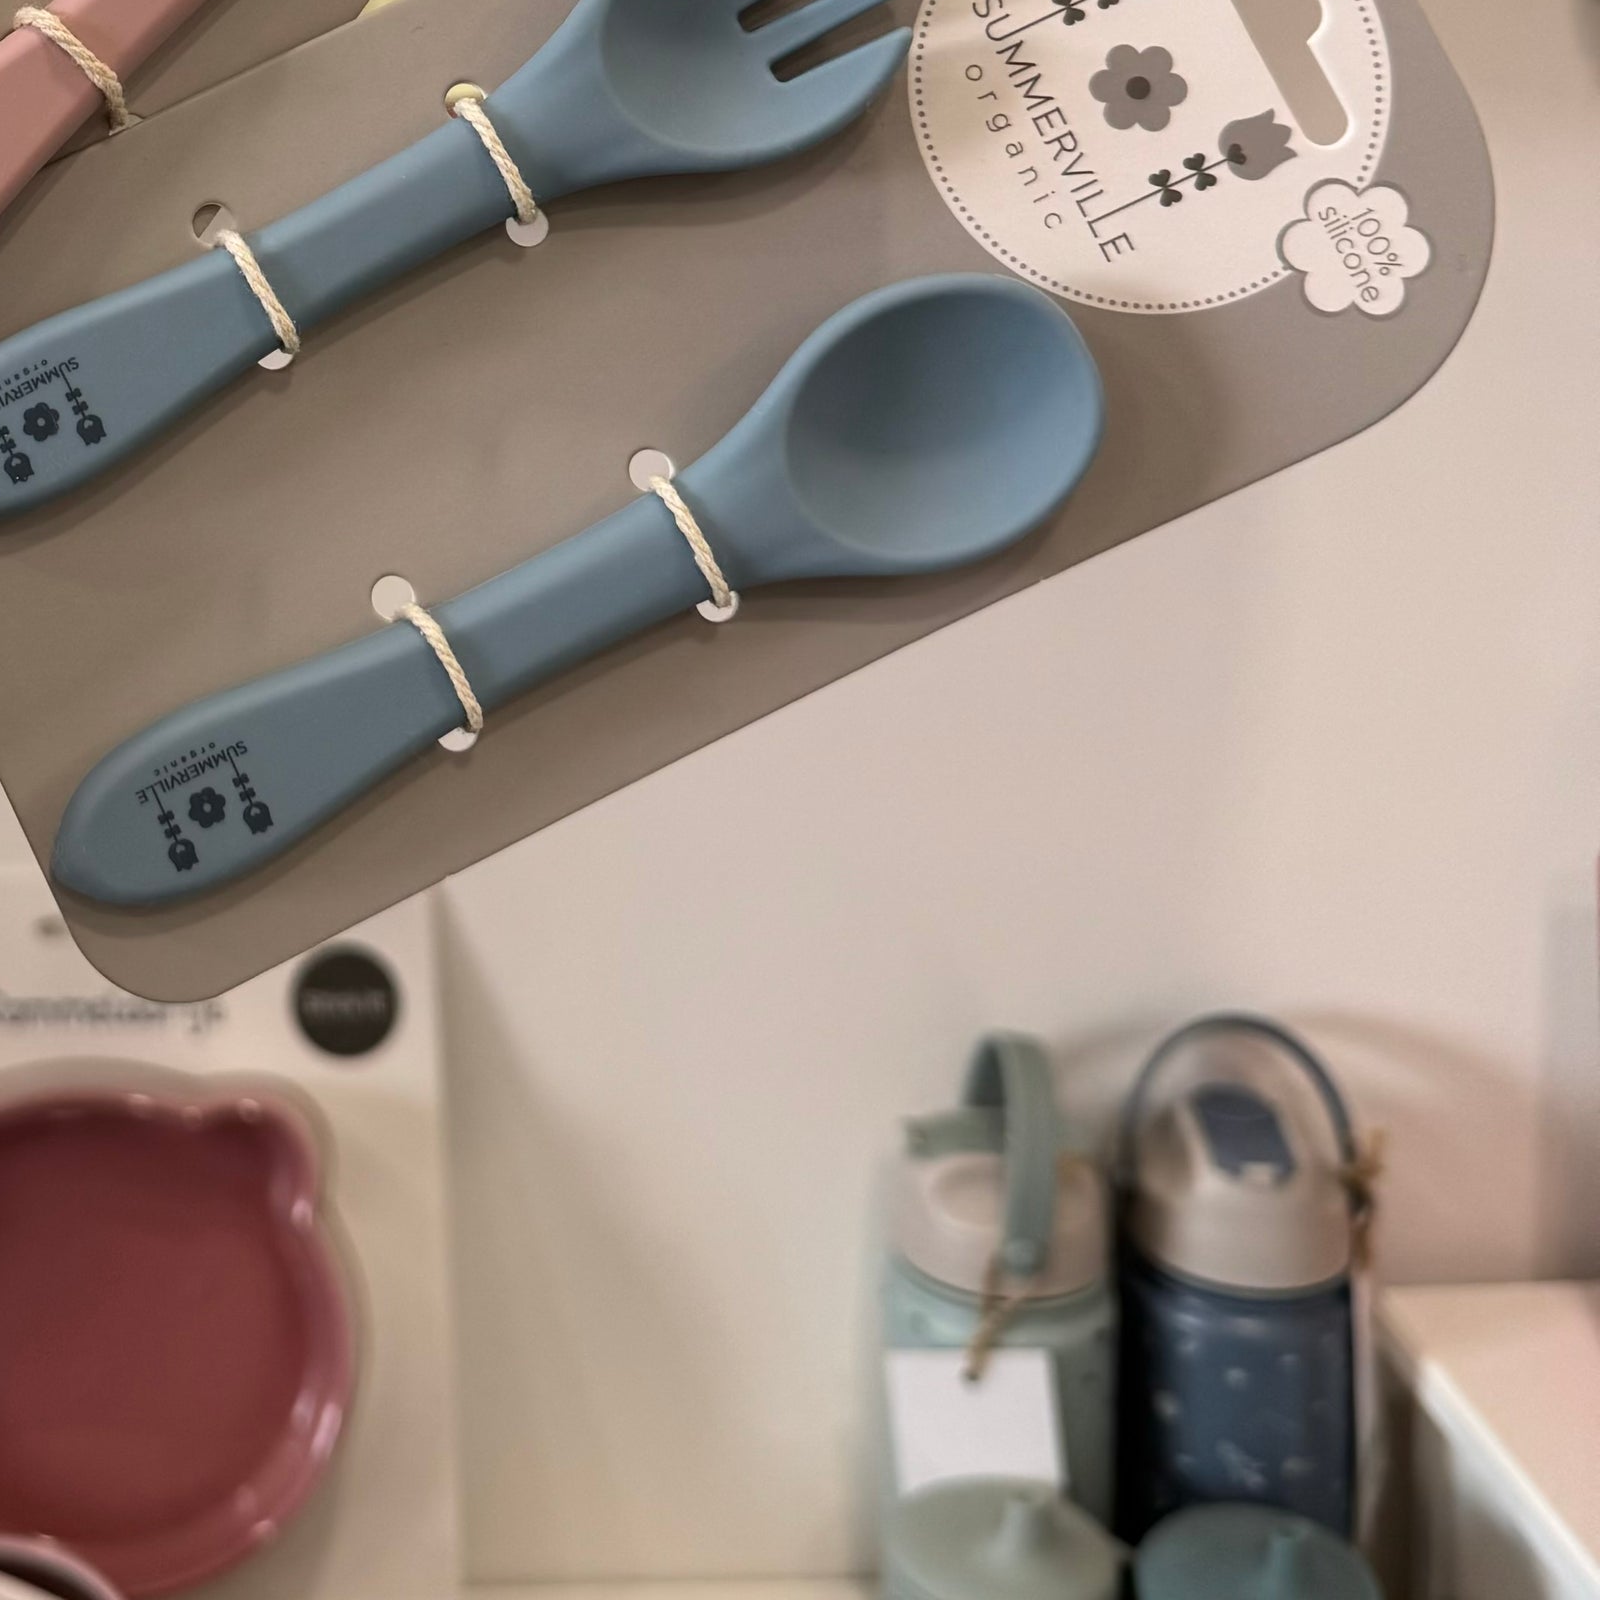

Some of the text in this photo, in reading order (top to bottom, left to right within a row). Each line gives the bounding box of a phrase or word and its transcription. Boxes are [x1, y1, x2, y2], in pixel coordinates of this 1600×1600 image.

[963, 61, 1064, 231] organic
[1316, 203, 1381, 305] silicone
[1353, 205, 1404, 279] 100%
[135, 740, 248, 805] SUMMERVILLE
[153, 742, 216, 777] organic
